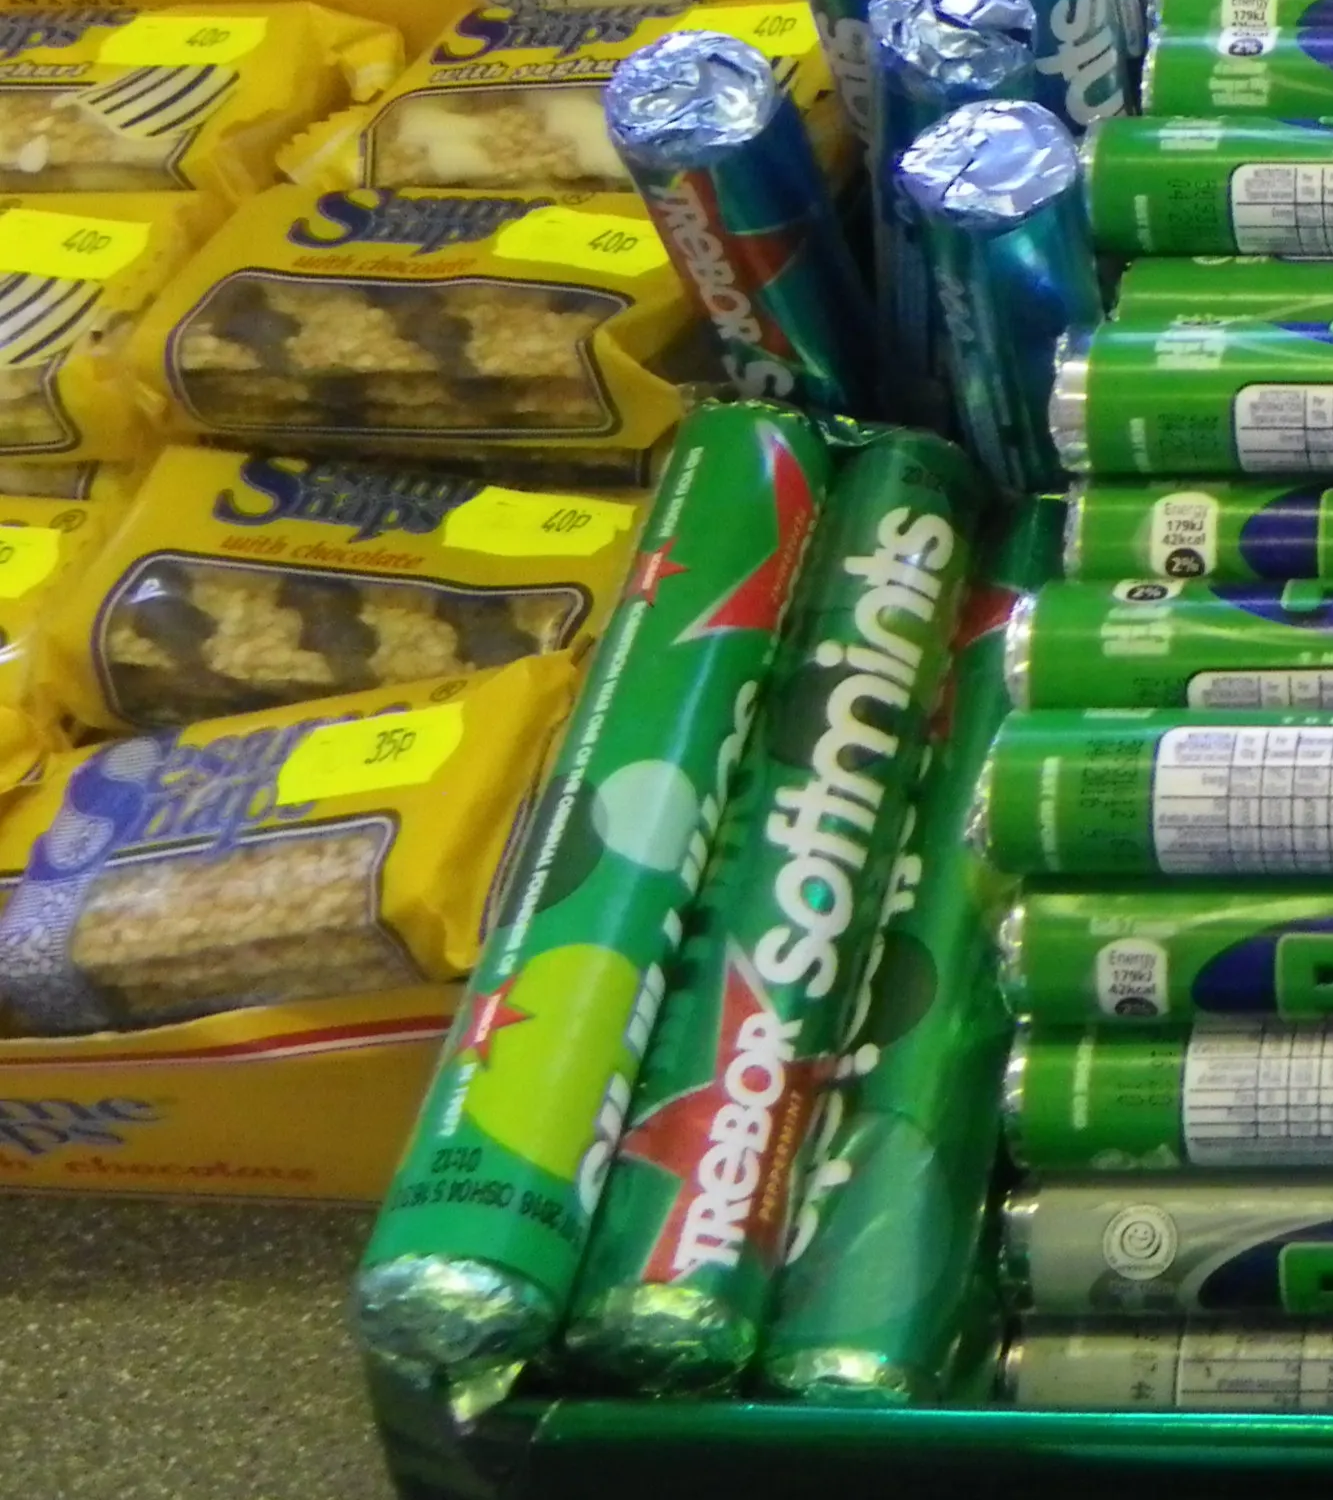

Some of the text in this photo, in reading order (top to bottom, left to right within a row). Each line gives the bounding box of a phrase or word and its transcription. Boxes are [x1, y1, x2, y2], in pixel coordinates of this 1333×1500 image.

[355, 253, 478, 276] chocolate
[1163, 503, 1209, 519] Energy
[219, 531, 426, 571] with chocolate
[1107, 949, 1157, 970] Energy
